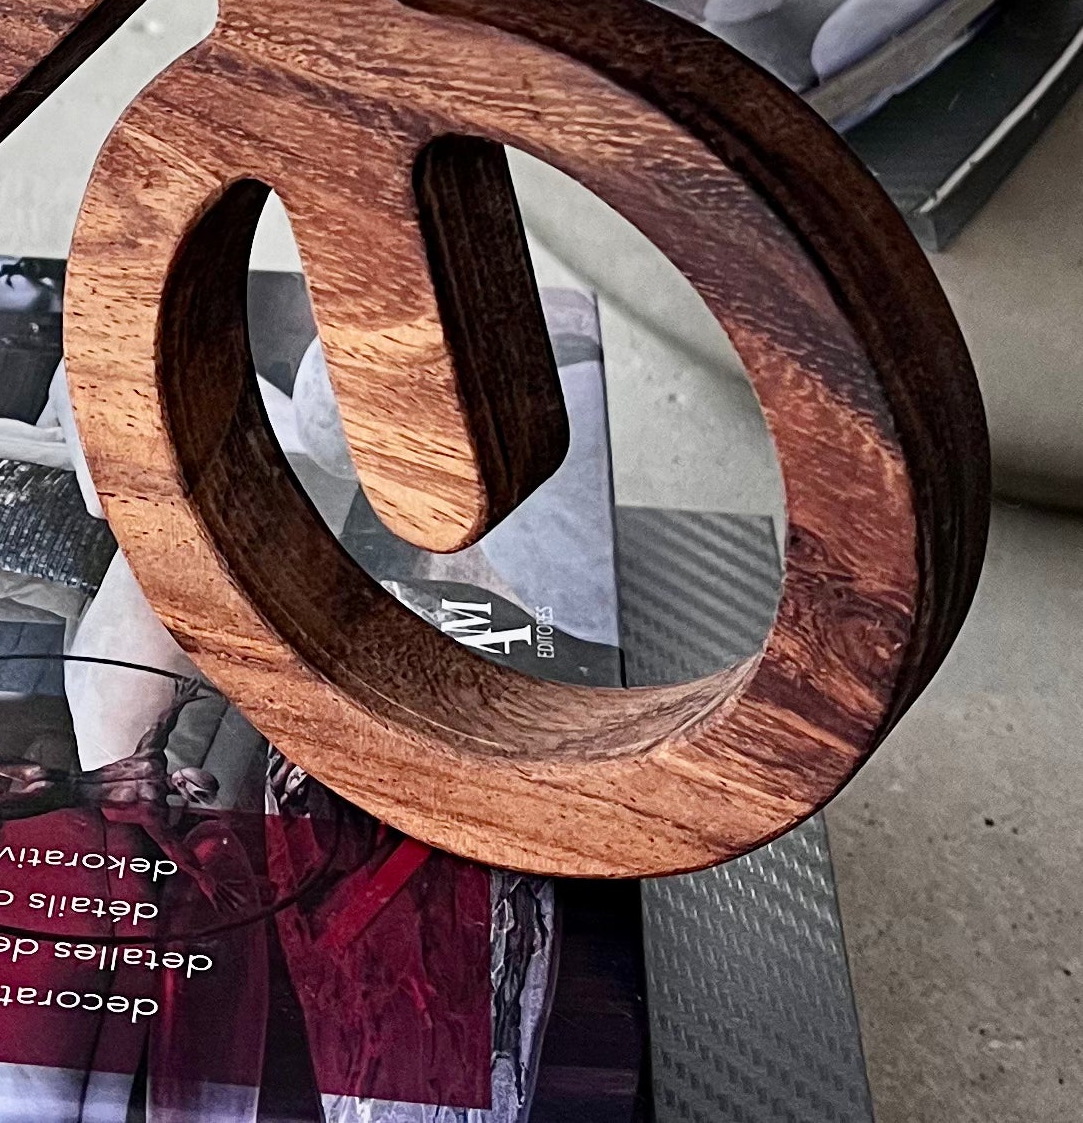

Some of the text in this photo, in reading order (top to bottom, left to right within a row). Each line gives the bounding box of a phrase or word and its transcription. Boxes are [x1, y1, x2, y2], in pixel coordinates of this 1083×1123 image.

[441, 599, 531, 654] AM
[536, 606, 554, 658] EDITORES
[29, 892, 159, 926] détails
[54, 941, 214, 979] detalles
